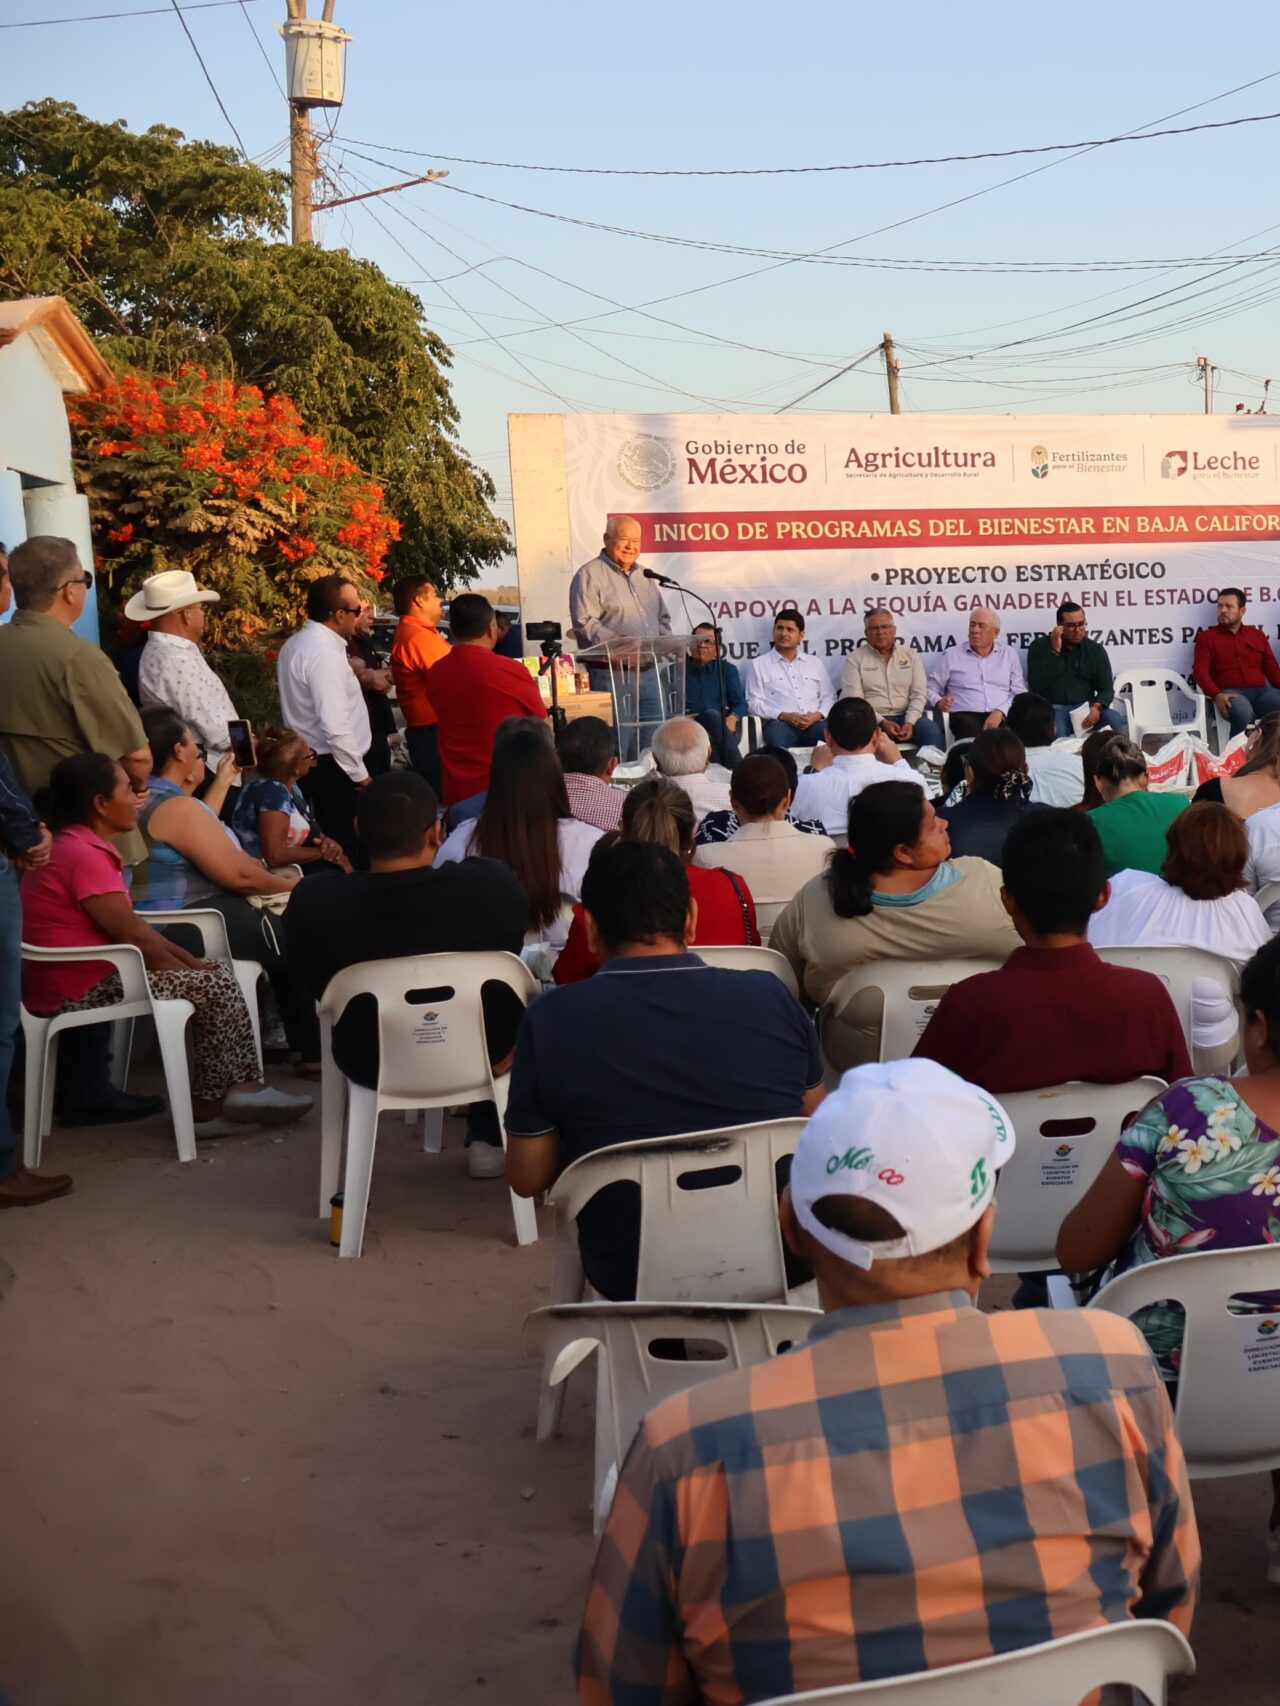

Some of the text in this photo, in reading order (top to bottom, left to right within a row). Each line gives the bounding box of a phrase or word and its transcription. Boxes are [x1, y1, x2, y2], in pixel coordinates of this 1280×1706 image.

[685, 439, 806, 455] Gobierno de
[1052, 451, 1128, 462] Fertilizantes
[844, 446, 996, 473] Agricultura
[1076, 462, 1128, 473] Bienestar
[1193, 451, 1260, 470] Leche
[687, 456, 807, 485] México
[888, 472, 924, 480] Agricultura
[1193, 471, 1260, 480] para el bienestar
[654, 522, 730, 542] INICIO
[737, 521, 768, 540] DE
[776, 518, 922, 540] PROGRAMAS
[928, 518, 972, 537] DEL
[978, 516, 1096, 536] BIENESTAR
[1102, 516, 1130, 533] EN
[1136, 515, 1189, 533] BAJA
[885, 558, 1166, 585] PROYECTO ESTRATÉGICO
[806, 598, 822, 616] A
[829, 597, 857, 616] LA
[954, 591, 1070, 612] GANADERA
[1081, 590, 1108, 608] EN
[1116, 590, 1138, 607] EL
[1144, 587, 1219, 606] ESTADO
[825, 634, 957, 657] PRAMA
